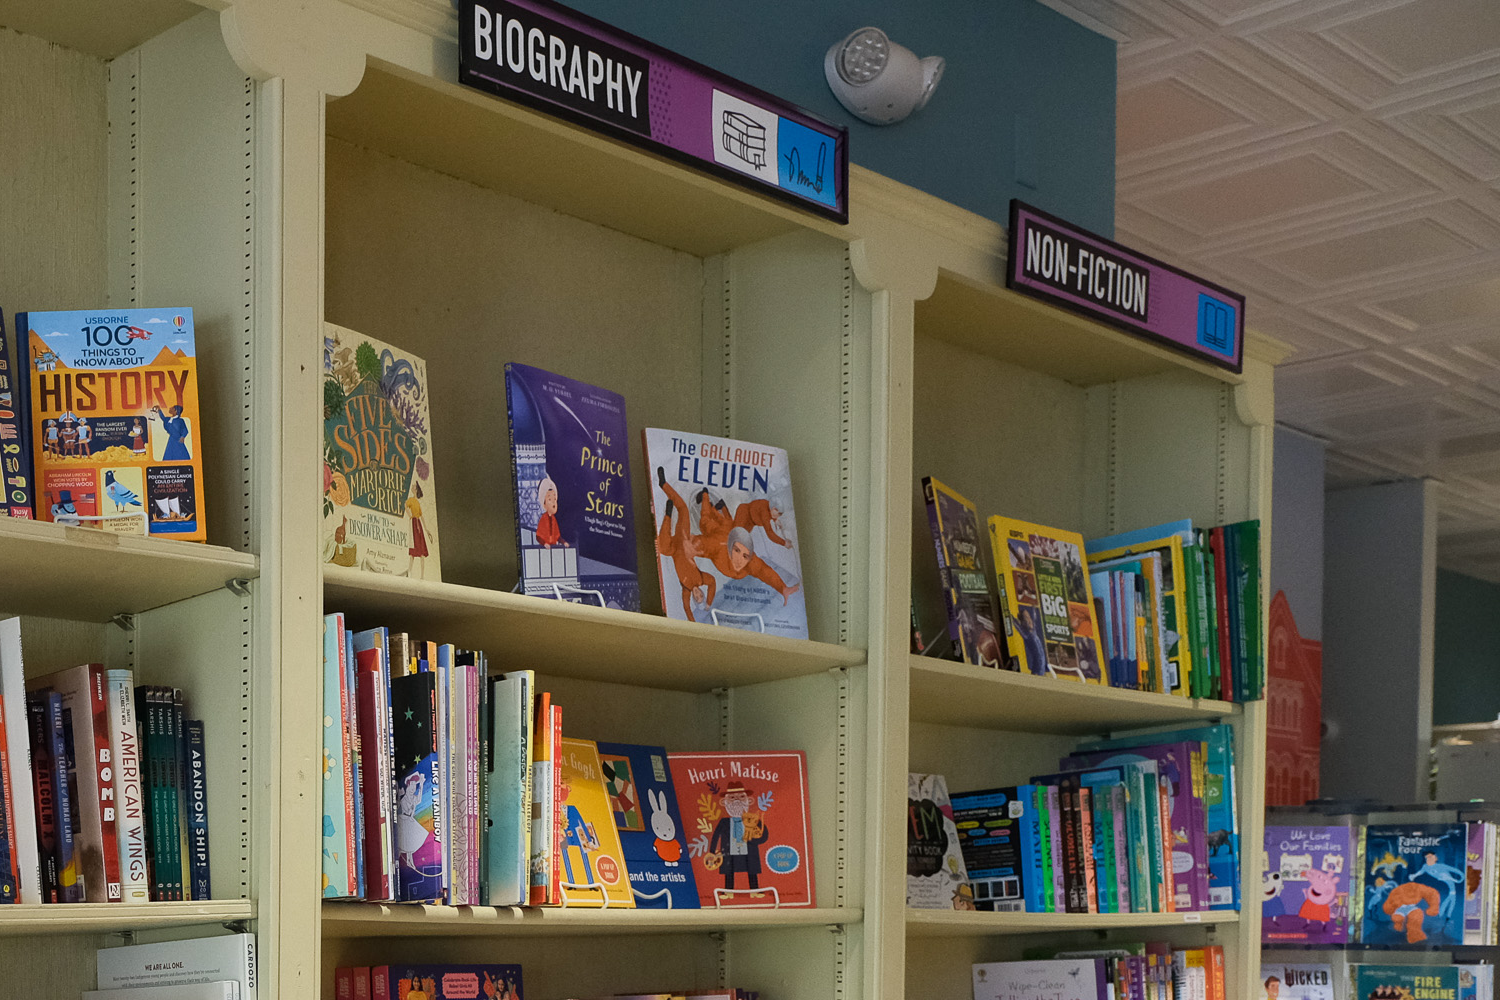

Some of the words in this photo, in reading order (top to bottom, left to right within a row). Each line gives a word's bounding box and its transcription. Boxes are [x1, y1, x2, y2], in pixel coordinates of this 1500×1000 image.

[473, 4, 643, 118] BIOGRAPHY
[1025, 227, 1147, 316] NON-FICTION
[85, 316, 129, 324] USBORNE
[81, 325, 134, 347] 100
[74, 358, 108, 367] KNOW
[109, 357, 145, 366] ABOUT
[82, 349, 121, 357] THINGS
[124, 348, 136, 356] TO
[39, 370, 189, 413] HISTORY
[345, 393, 393, 436] FIVE
[333, 423, 411, 476] SIDES
[596, 430, 611, 447] The
[670, 437, 698, 457] The
[700, 442, 775, 469] GALLAUDET
[580, 447, 624, 478] Prince
[677, 455, 770, 494] ELEVEN
[349, 469, 406, 509] MARJORIE
[600, 477, 611, 496] of
[378, 489, 404, 516] RICE
[585, 491, 625, 519] Stars
[121, 731, 140, 819] AMERICAN
[192, 750, 205, 823] ABANDON
[687, 764, 725, 785] Henri
[729, 761, 780, 783] Matisse
[128, 826, 145, 882] WINGS
[196, 828, 206, 867] SHIP!
[1284, 967, 1328, 986] WICKED
[1414, 976, 1441, 988] FIRE
[1414, 988, 1455, 1000] ENGINE
